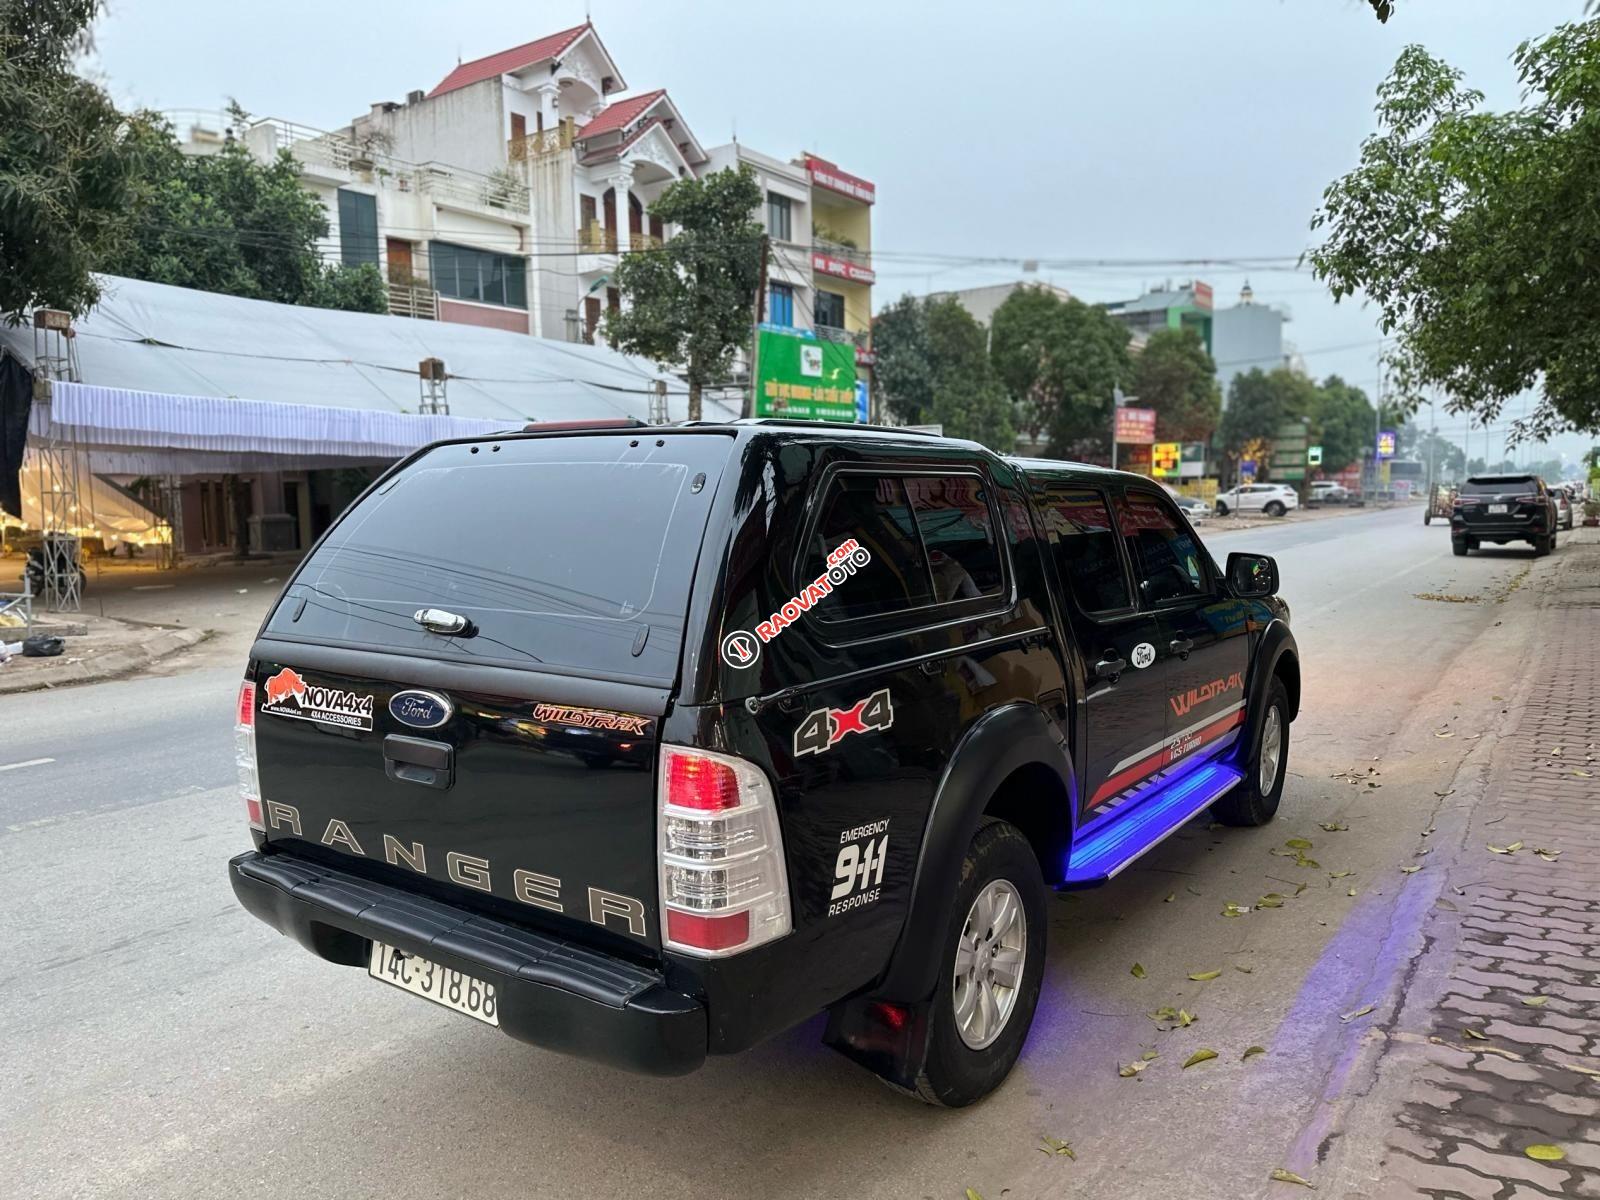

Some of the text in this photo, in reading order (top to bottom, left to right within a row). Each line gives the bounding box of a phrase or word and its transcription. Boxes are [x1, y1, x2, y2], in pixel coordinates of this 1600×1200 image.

[1169, 671, 1243, 717] WILDTRAK
[321, 713, 362, 727] ACCESSORIES
[532, 703, 652, 735] WILDTRAK
[839, 818, 890, 844] EMERGENCY
[267, 800, 647, 937] RANGER
[828, 888, 881, 917] RESPONSE
